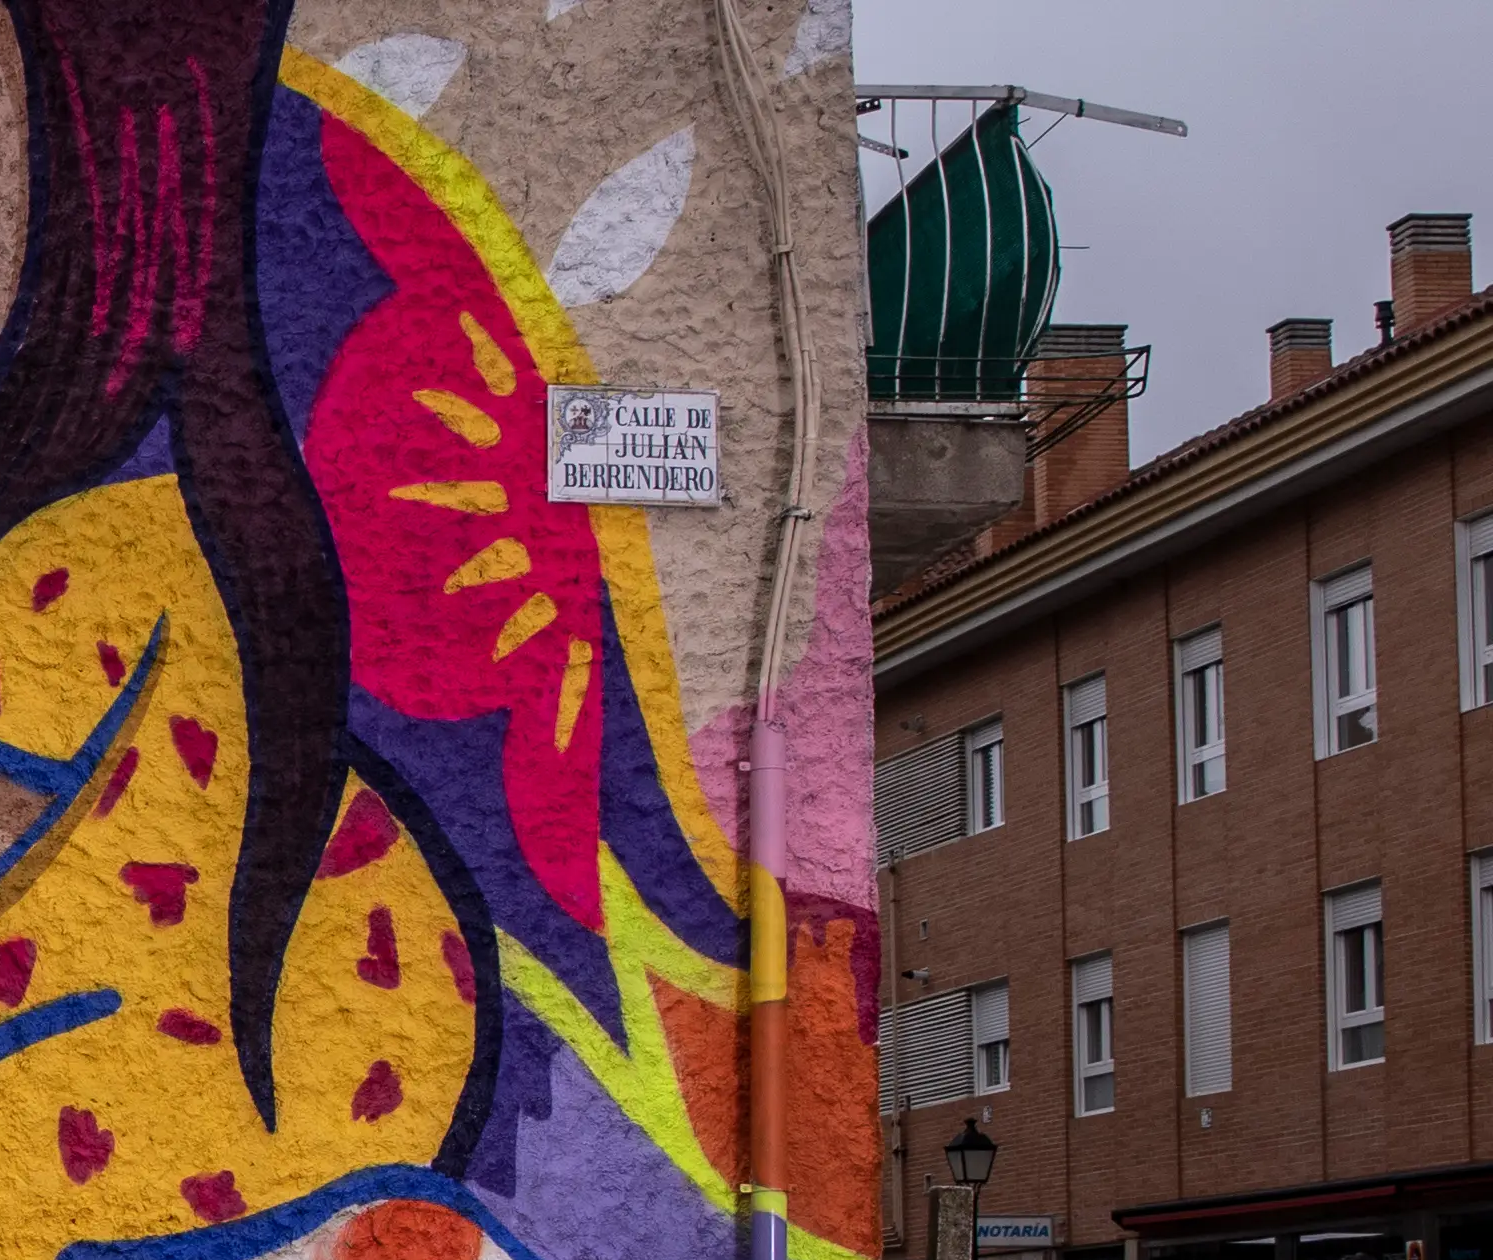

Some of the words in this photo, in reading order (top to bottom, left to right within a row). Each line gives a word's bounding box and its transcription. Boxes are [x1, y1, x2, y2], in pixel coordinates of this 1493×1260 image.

[615, 406, 676, 428] CALLE
[687, 407, 712, 429] DE
[563, 463, 714, 491] BERRENDERO
[977, 1222, 1049, 1238] NOTARÍA
